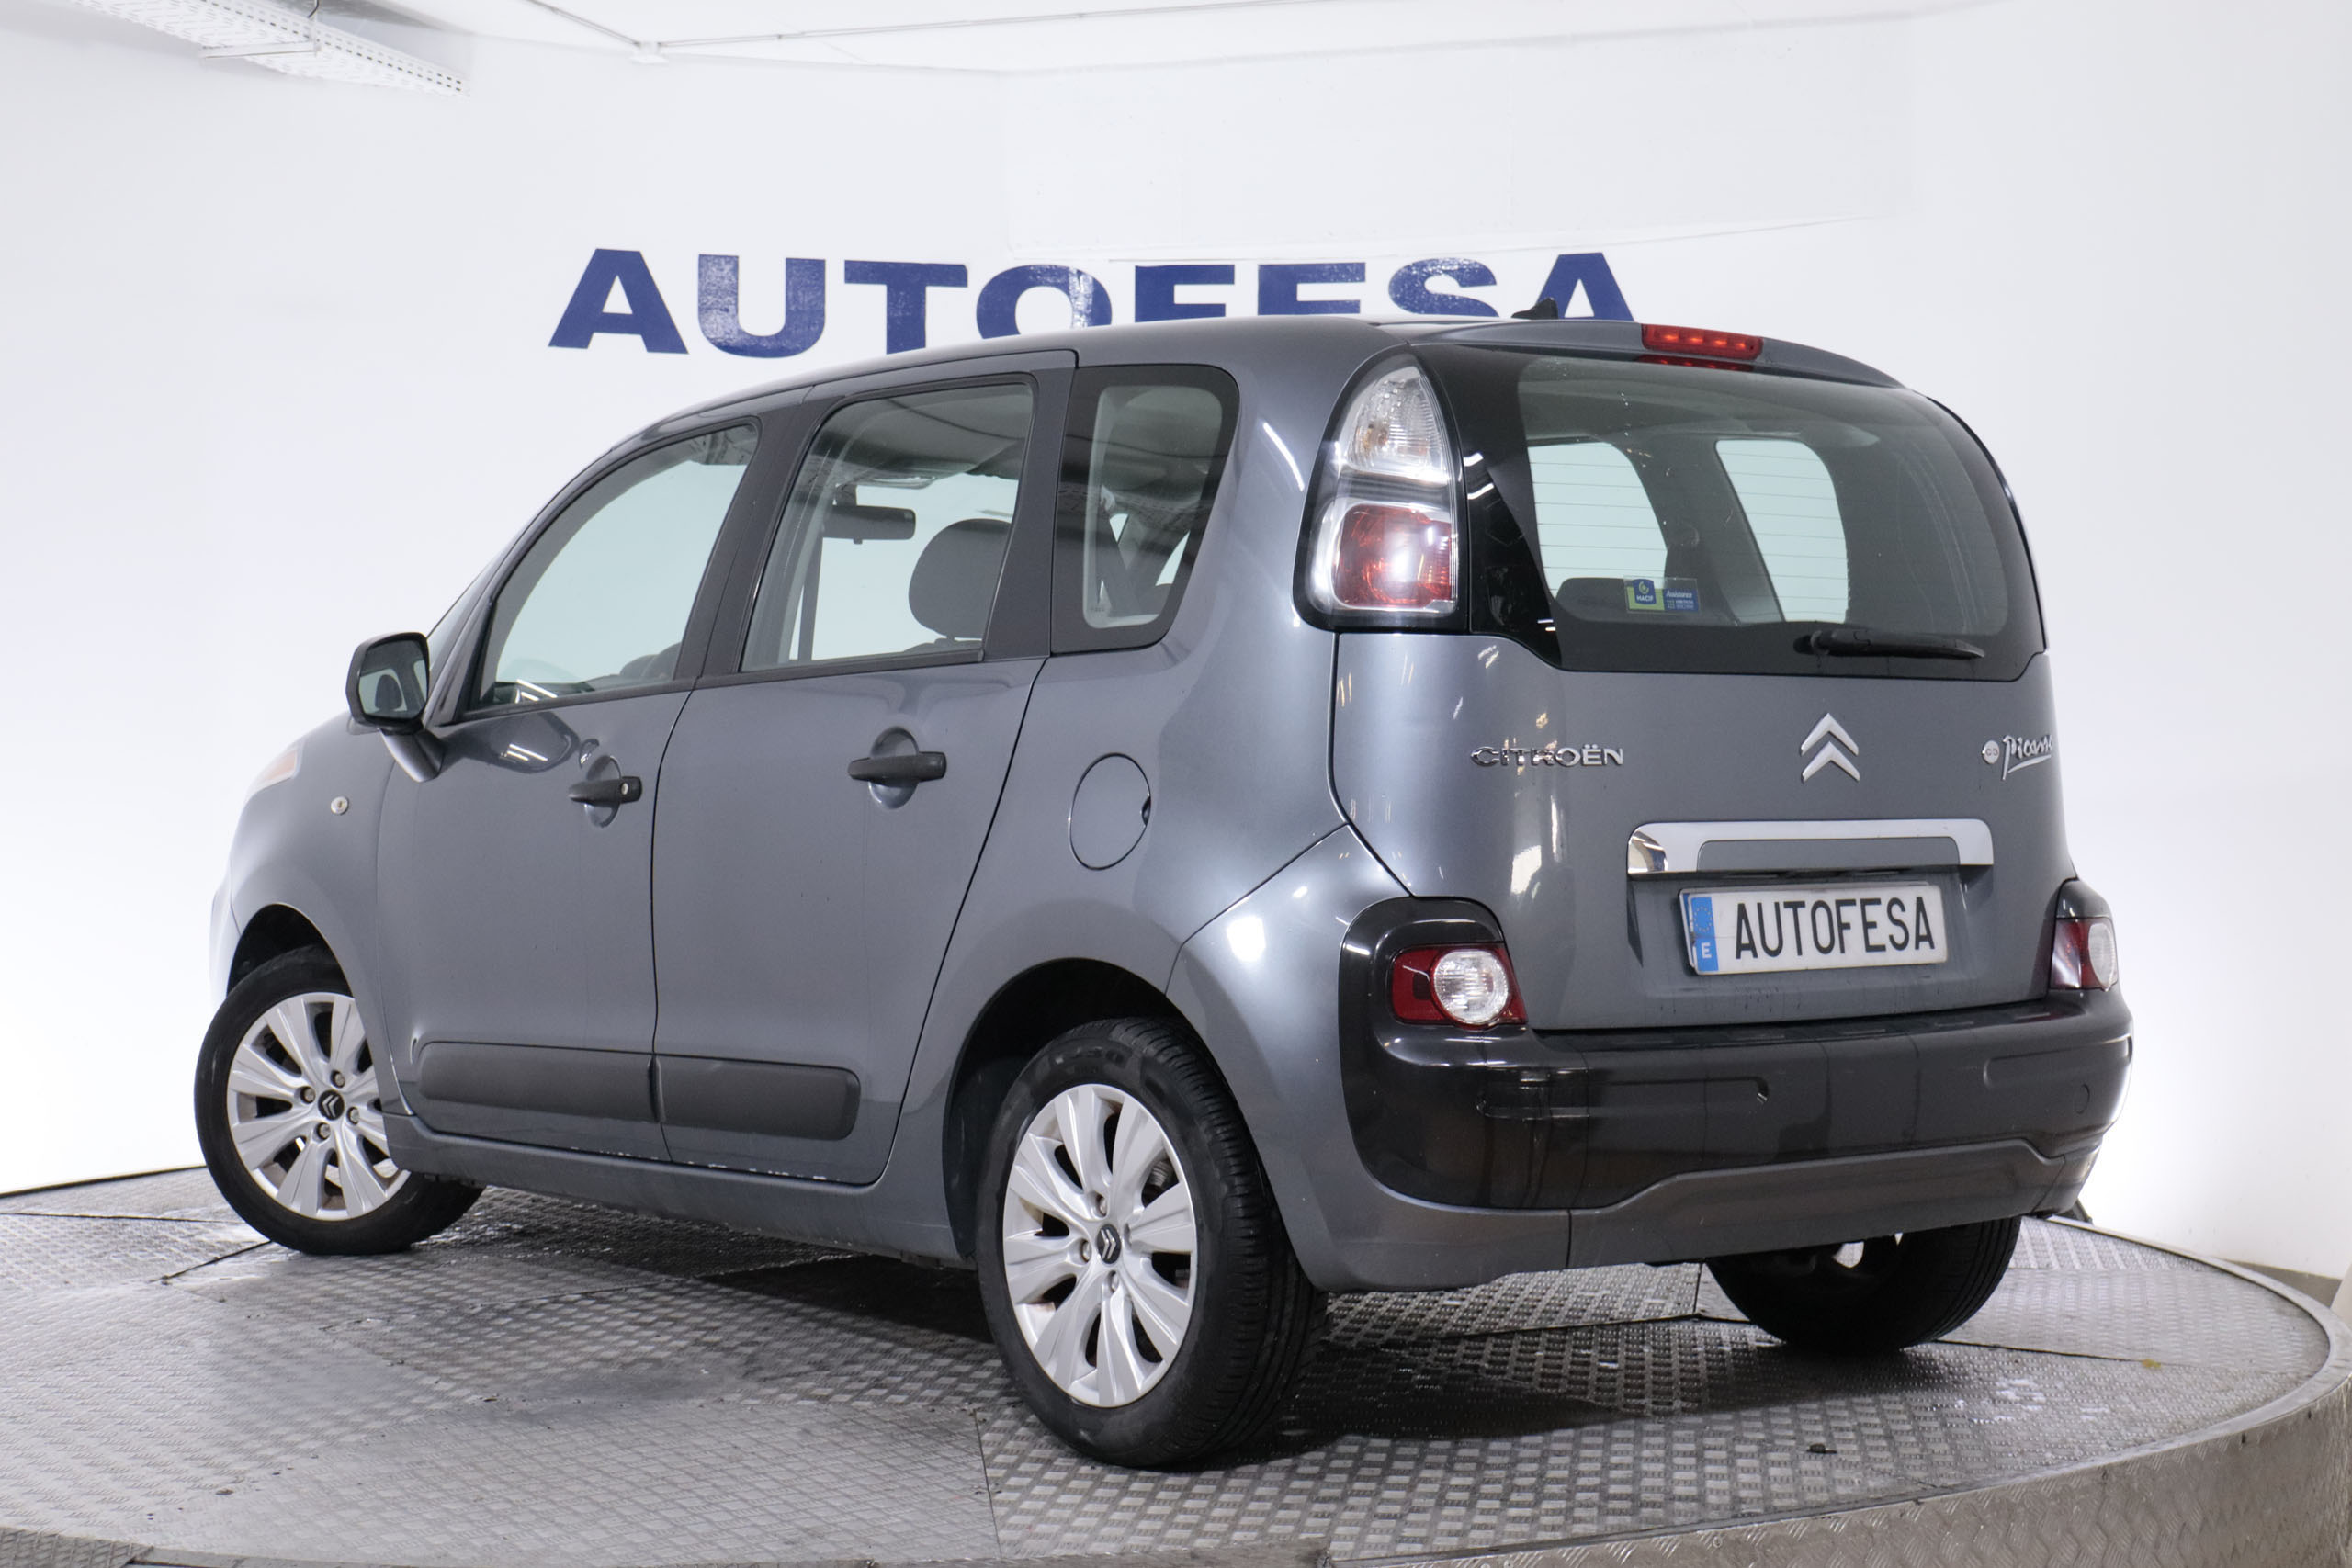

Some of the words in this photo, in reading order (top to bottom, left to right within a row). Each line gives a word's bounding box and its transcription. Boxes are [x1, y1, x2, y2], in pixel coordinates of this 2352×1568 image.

[1470, 744, 1623, 766] CITROËN
[1701, 942, 1712, 959] E
[1736, 896, 1935, 960] AUTOFESA
